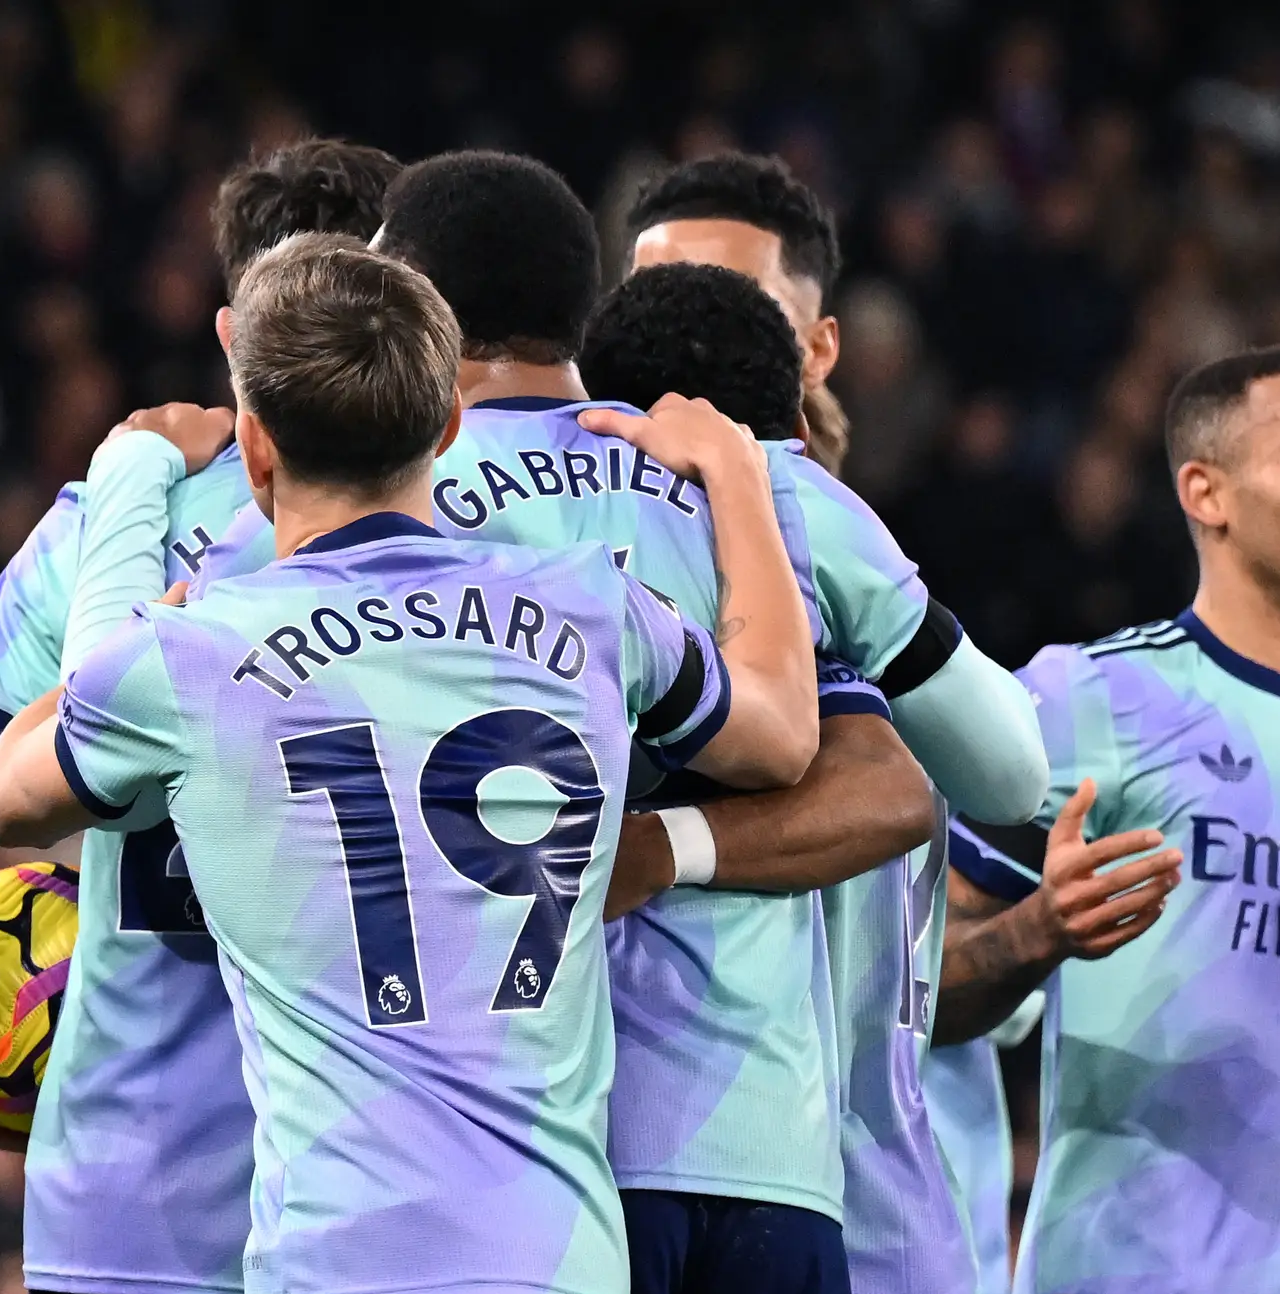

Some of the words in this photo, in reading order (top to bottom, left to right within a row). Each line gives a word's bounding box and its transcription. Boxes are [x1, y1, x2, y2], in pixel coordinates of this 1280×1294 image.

[430, 446, 700, 531] GABRIEL
[230, 585, 587, 703] TROSSARD
[275, 707, 606, 1029] 19
